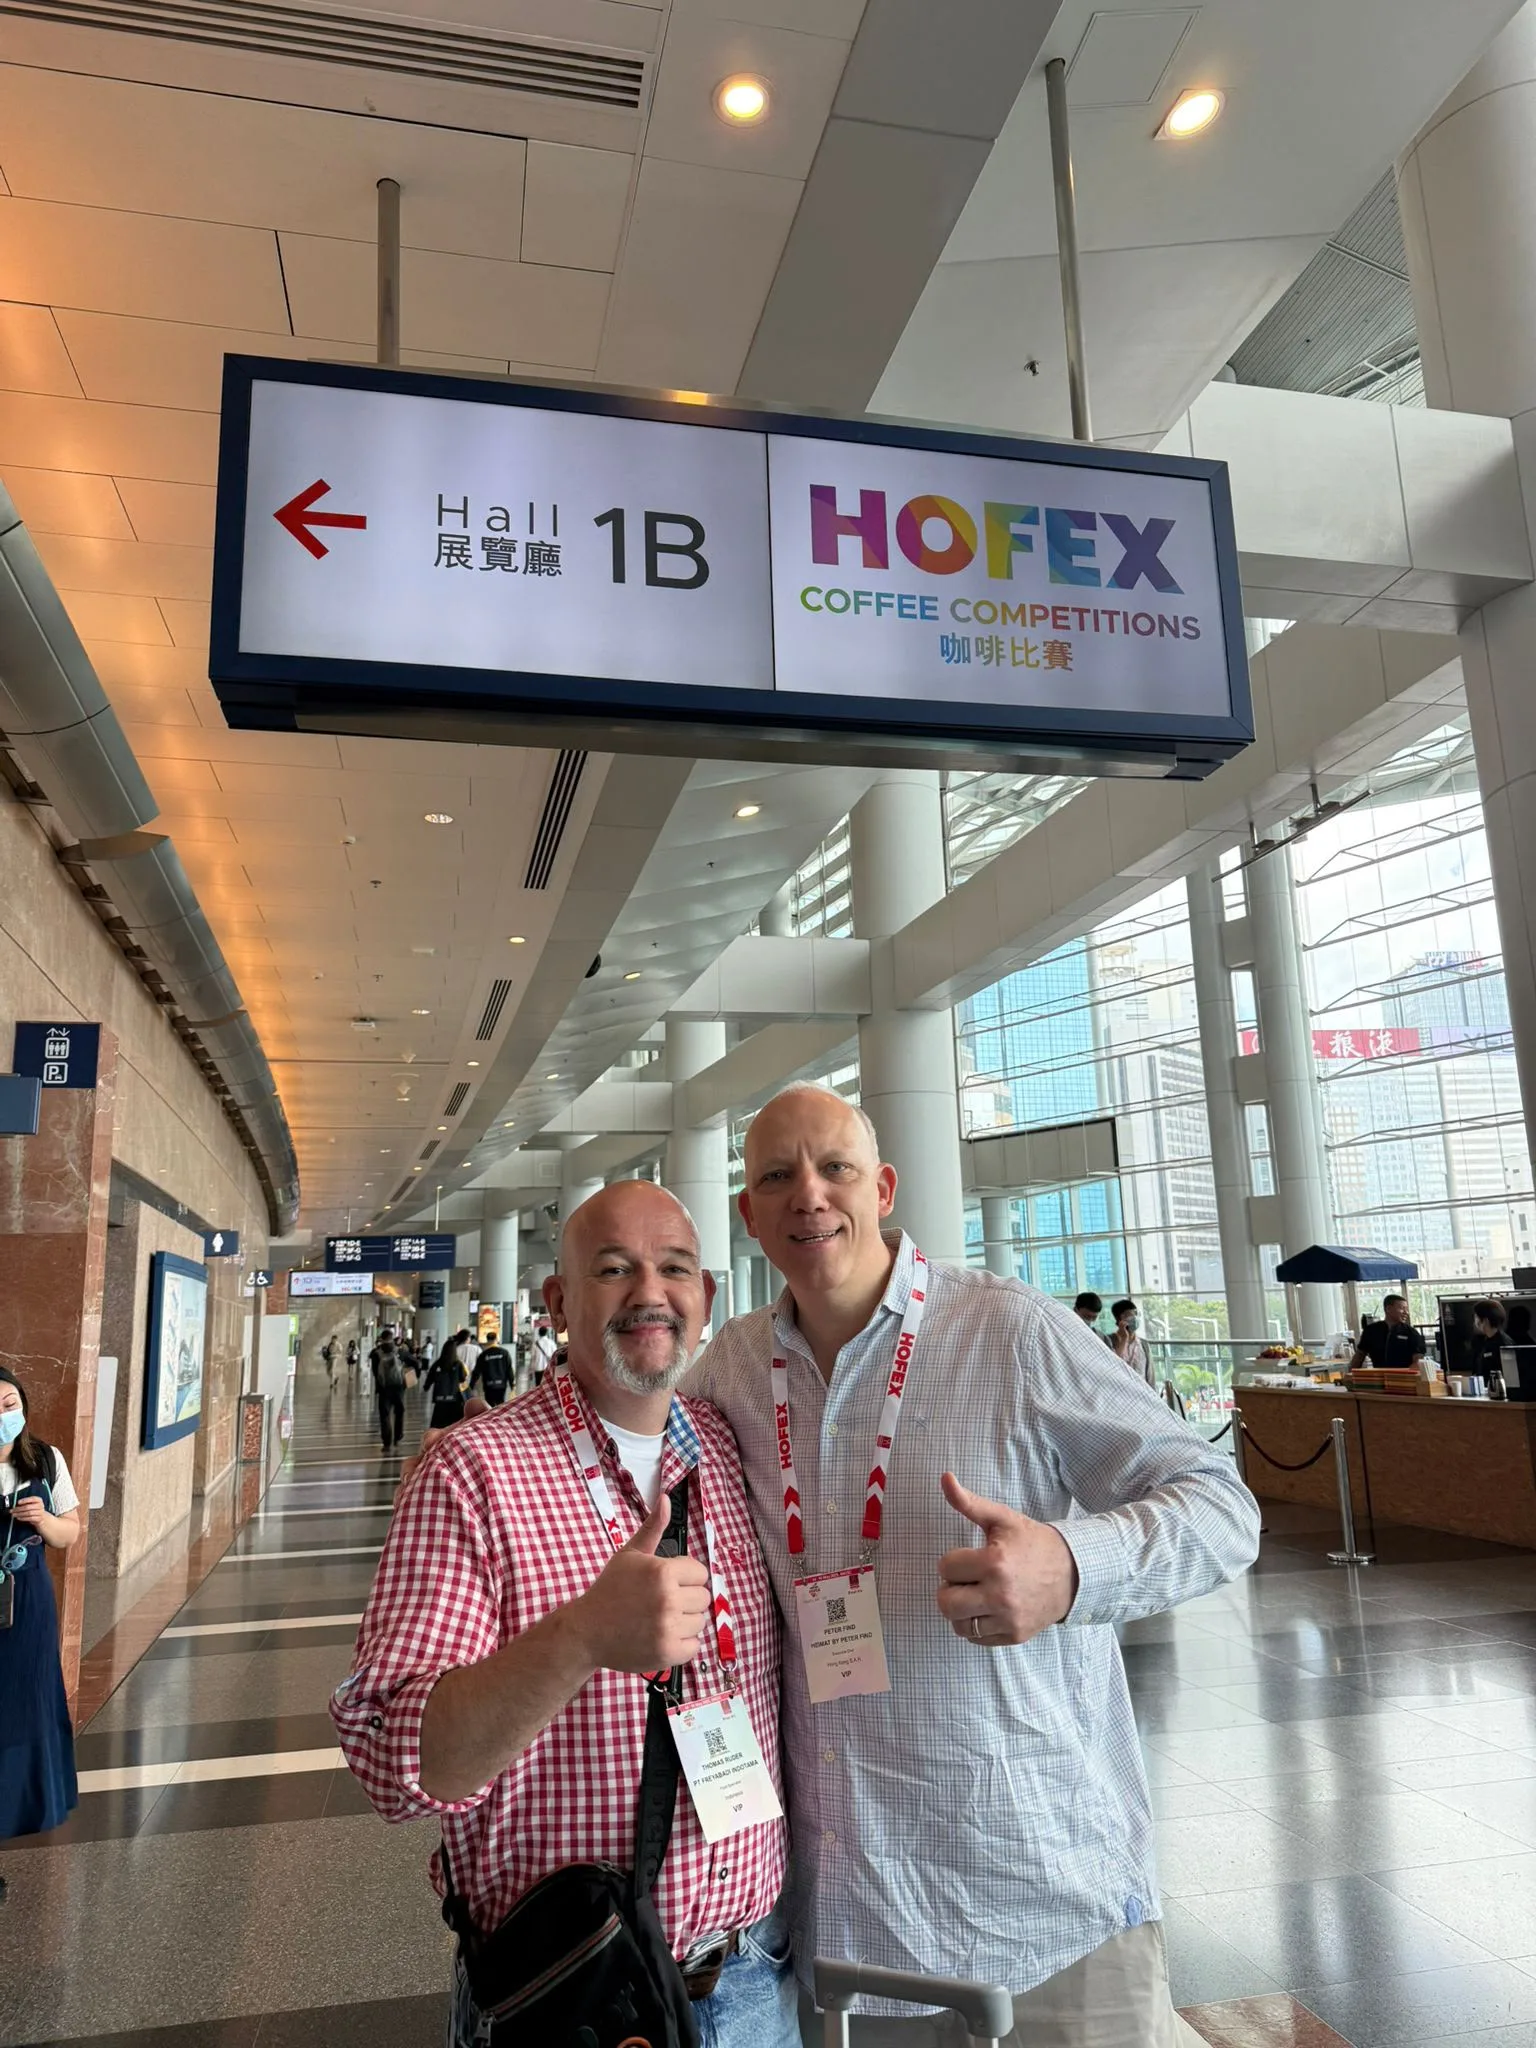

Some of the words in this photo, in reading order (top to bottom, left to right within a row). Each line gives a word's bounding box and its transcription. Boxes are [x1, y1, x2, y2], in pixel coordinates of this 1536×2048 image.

[436, 493, 559, 537] Hall
[810, 484, 1185, 595] HOFEX
[433, 532, 562, 577] 展覽廳
[593, 507, 710, 590] 1B
[800, 586, 940, 622] COFFEE
[949, 598, 1202, 641] COMPETITIONS
[940, 631, 1074, 672] 咖啡比賽
[887, 1332, 915, 1398] HOFEX
[557, 1373, 585, 1433] HOFEX
[775, 1400, 793, 1470] HOFEX
[841, 1670, 852, 1678] VIP
[702, 1759, 725, 1770] THOMAS
[733, 1803, 743, 1812] VIP
